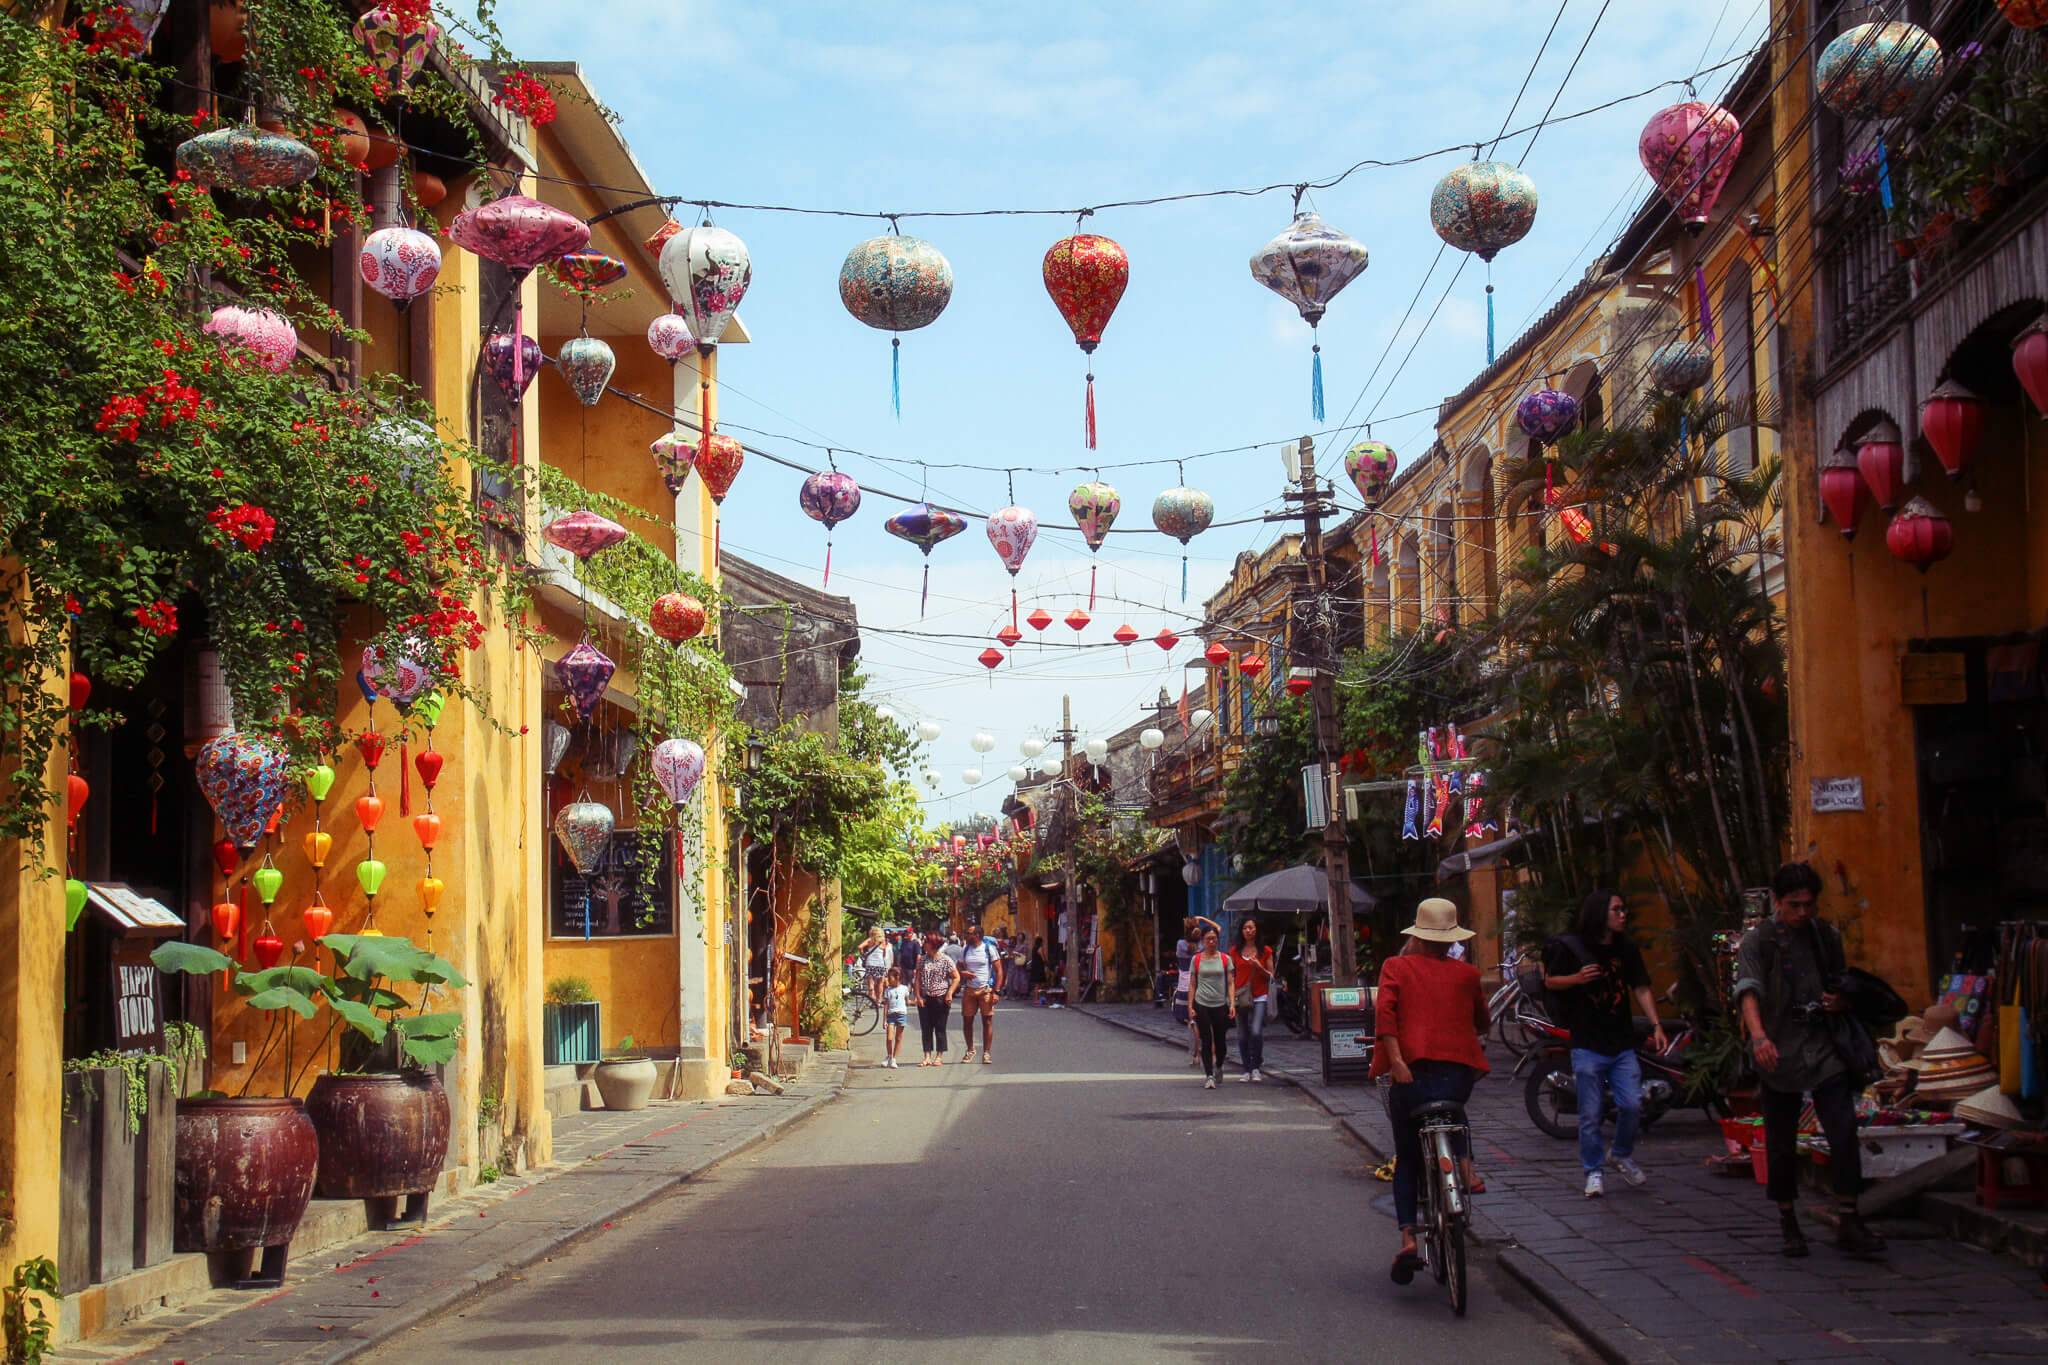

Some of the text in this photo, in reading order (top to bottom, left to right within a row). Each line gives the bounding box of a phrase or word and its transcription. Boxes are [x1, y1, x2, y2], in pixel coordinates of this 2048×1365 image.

[1817, 783, 1856, 792] MONEY
[1815, 797, 1859, 807] CHANGE
[119, 966, 154, 998] HAPPY
[119, 996, 155, 1037] HOUR
